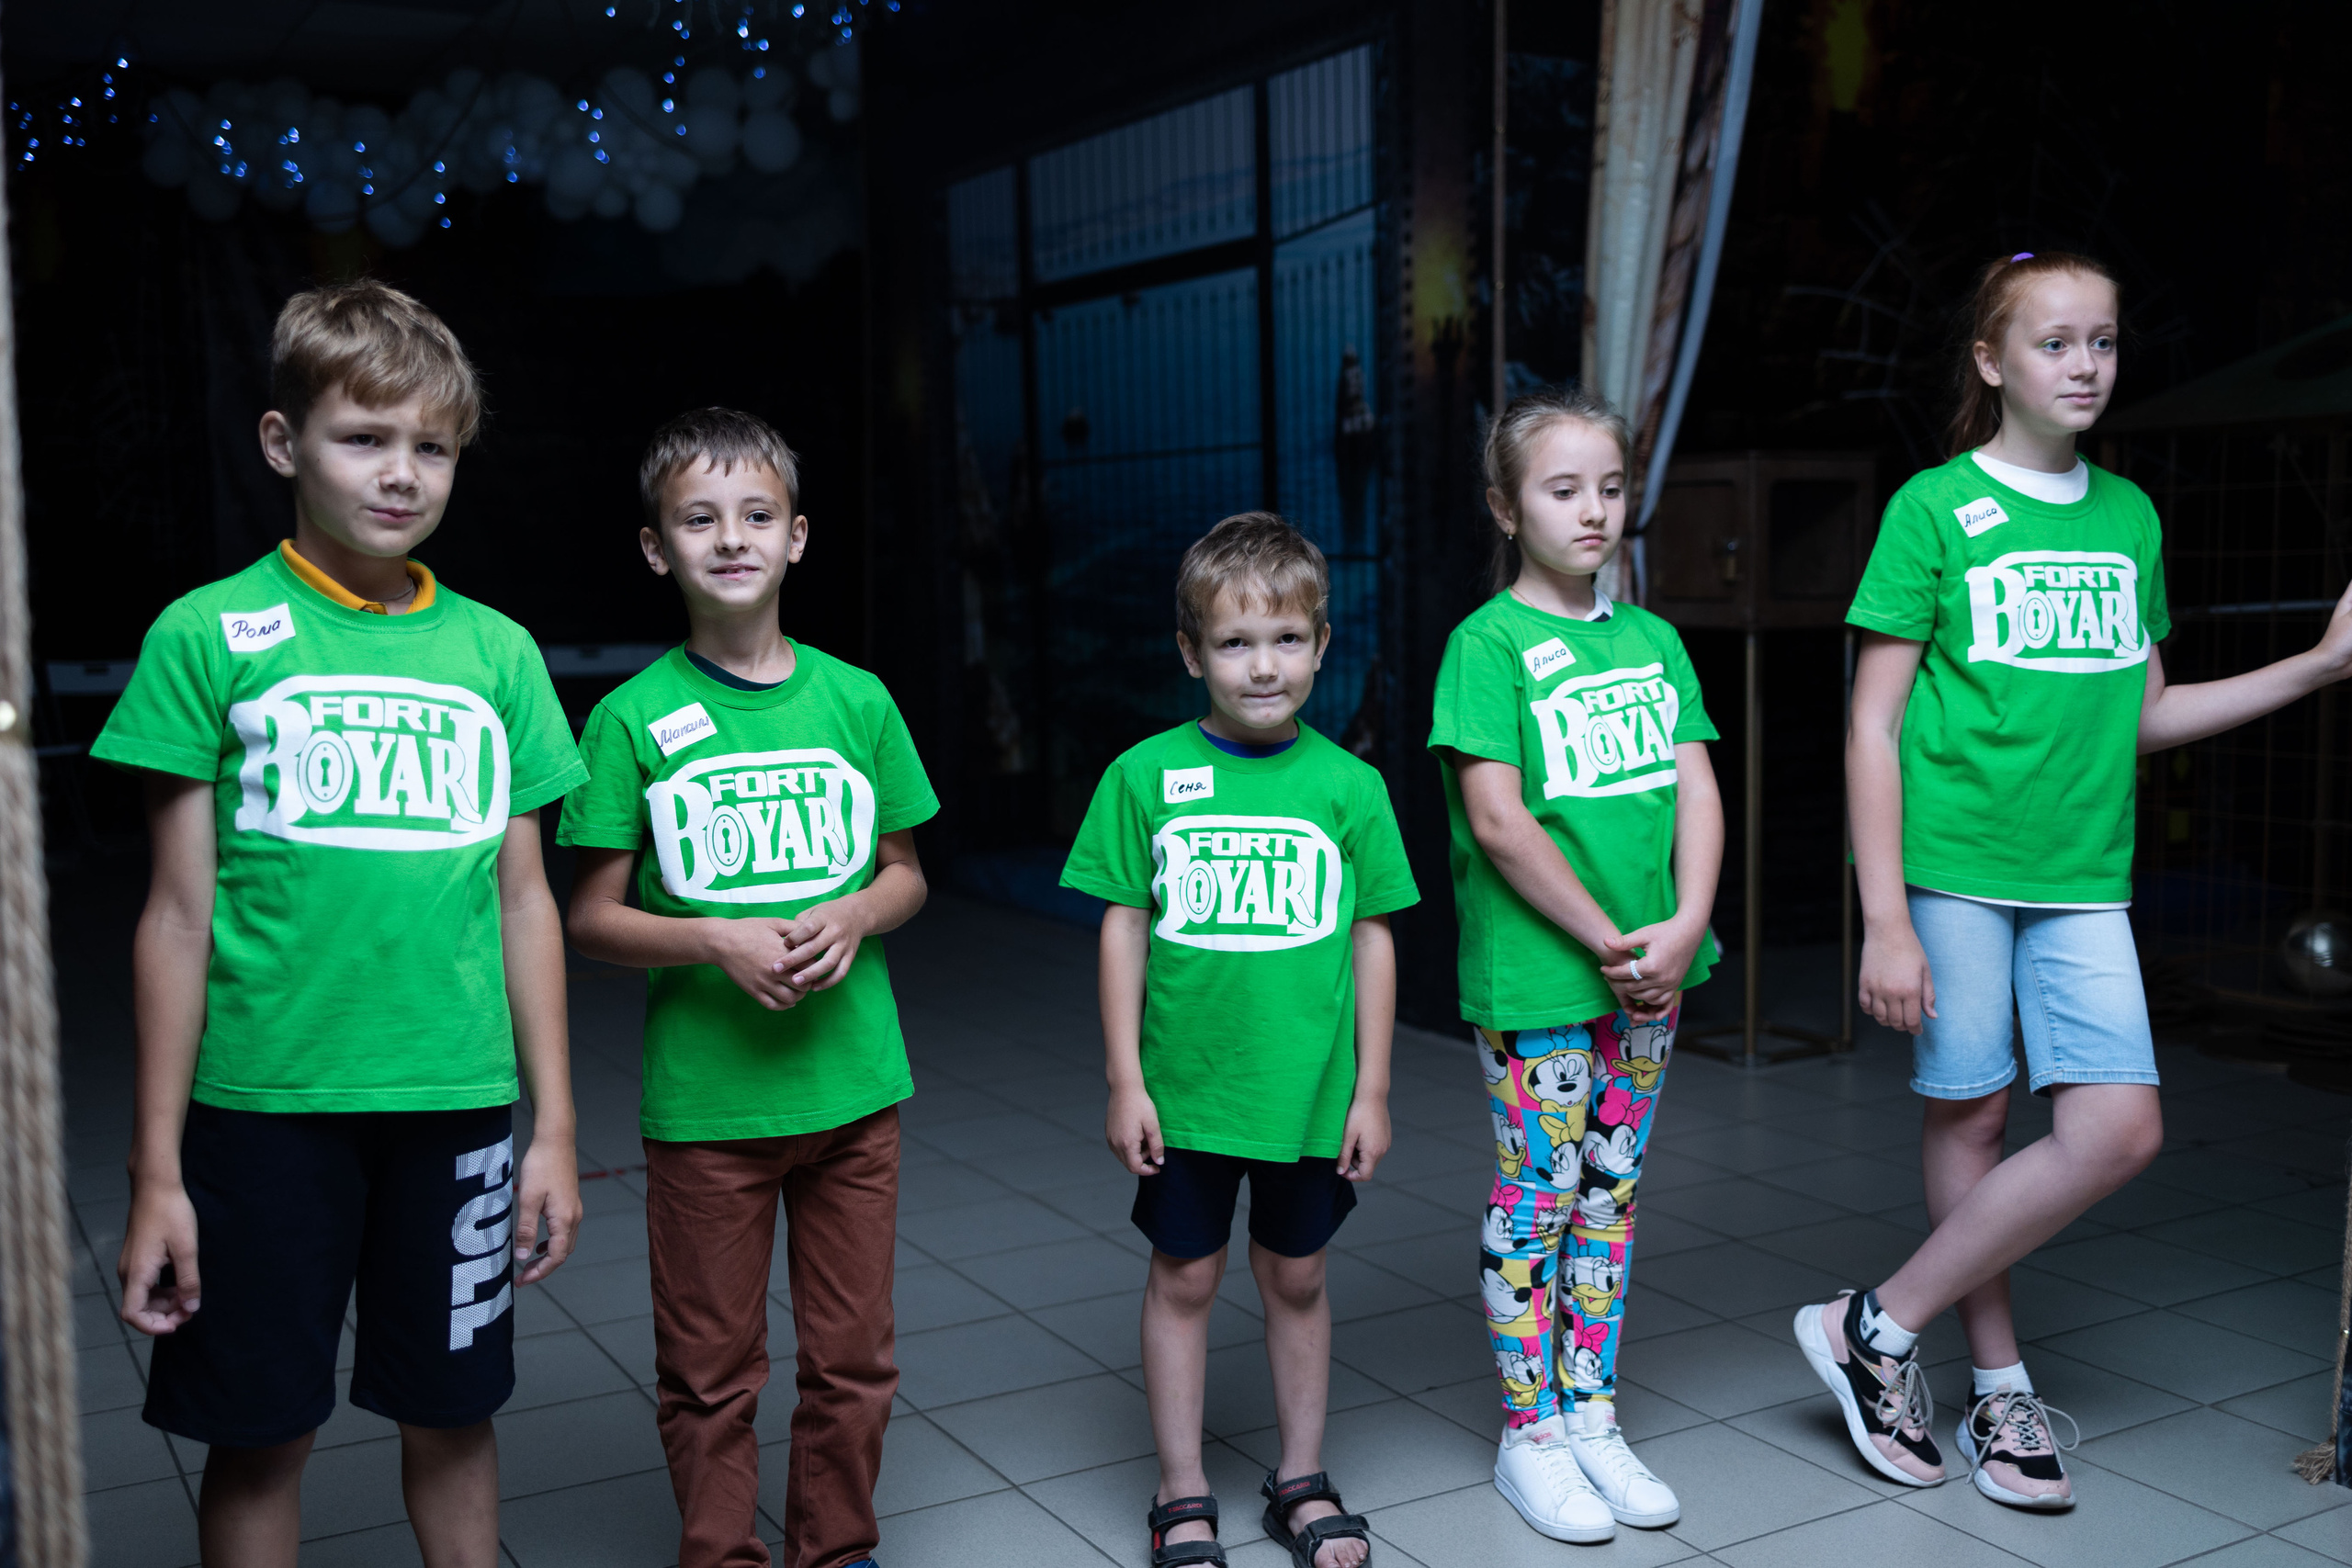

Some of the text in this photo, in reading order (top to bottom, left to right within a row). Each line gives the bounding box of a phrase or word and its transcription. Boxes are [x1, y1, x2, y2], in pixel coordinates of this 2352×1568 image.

[1964, 507, 1997, 528] Алиса
[2022, 565, 2113, 588] FORT
[232, 619, 281, 638] Рома
[1532, 648, 1567, 673] Алиса
[1580, 677, 1665, 715] FORT
[310, 695, 449, 733] FORT
[230, 693, 510, 840] BOYARD
[708, 766, 820, 802] FORT
[1170, 781, 1207, 795] Сеня
[645, 762, 875, 898] BOYARD
[1189, 831, 1293, 856] FORT
[1151, 829, 1342, 941] BOYARD
